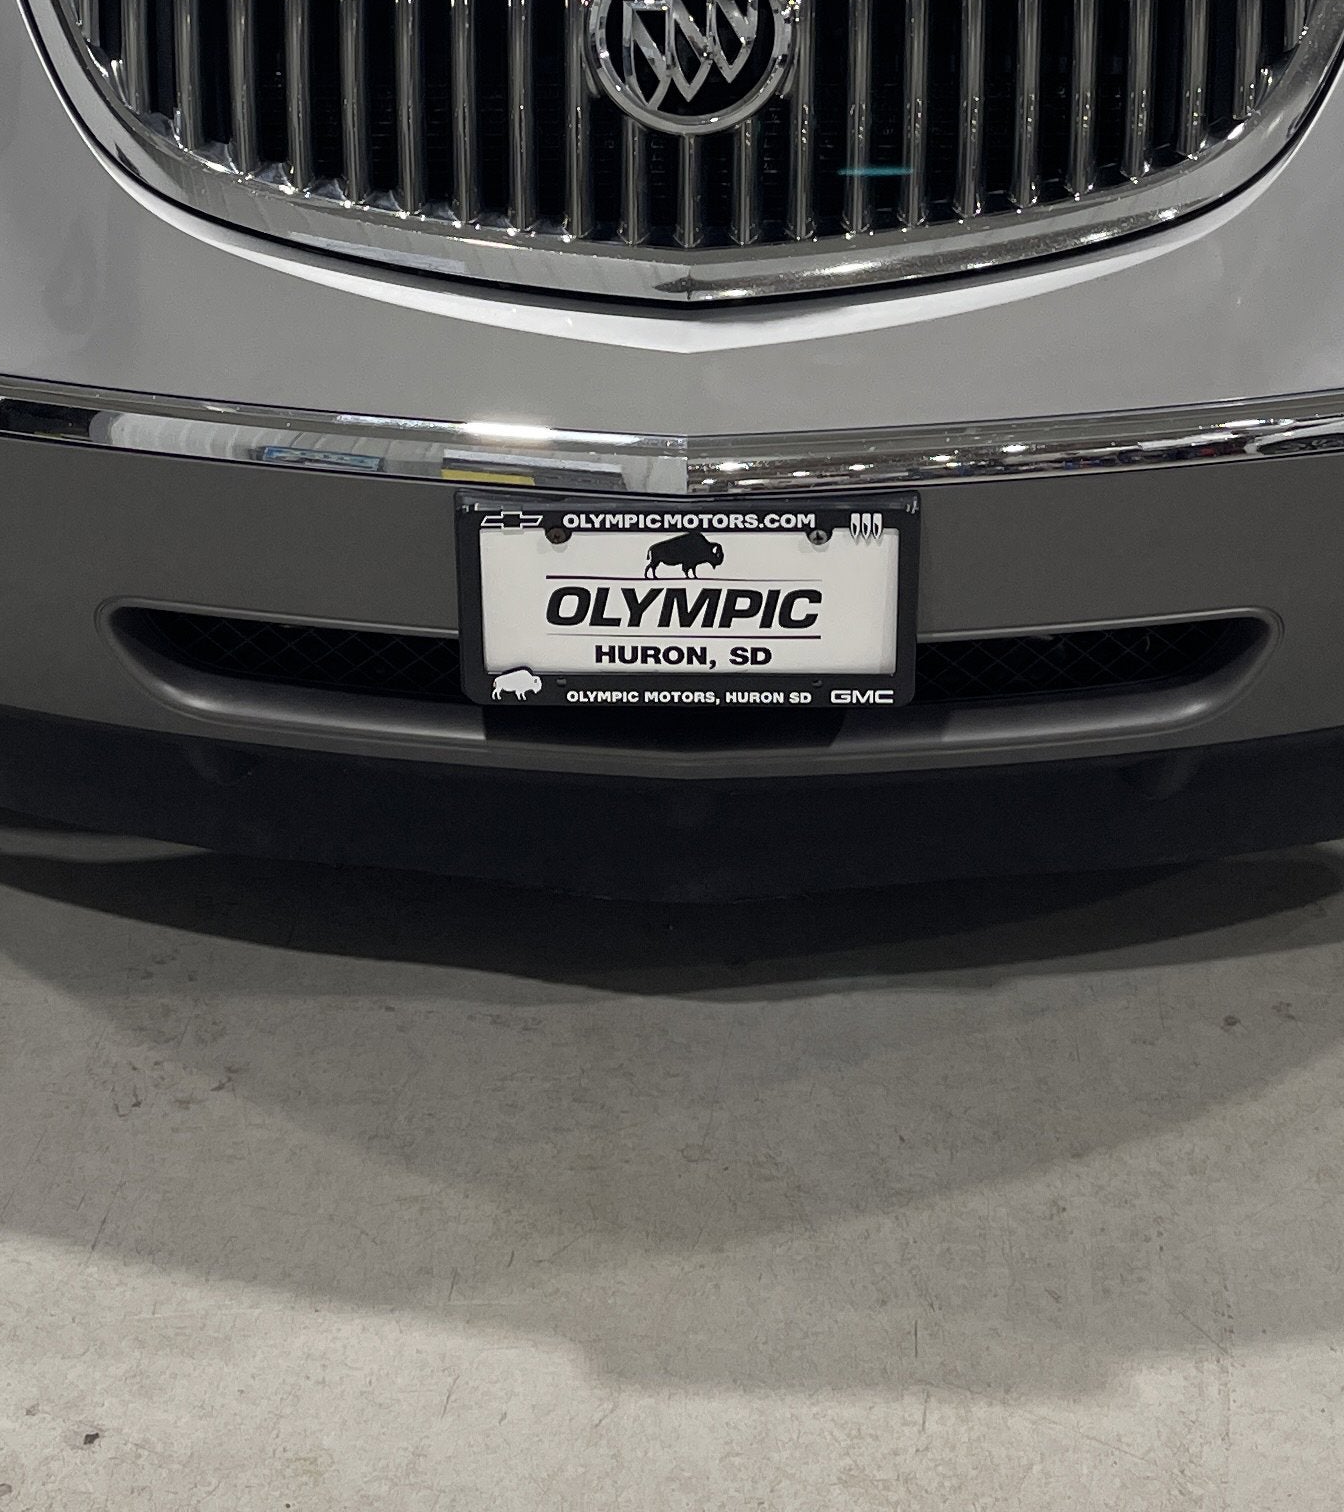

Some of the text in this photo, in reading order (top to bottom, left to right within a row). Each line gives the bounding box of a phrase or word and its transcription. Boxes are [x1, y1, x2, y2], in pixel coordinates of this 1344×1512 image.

[562, 513, 816, 529] OLYMPICMOTORS.COM
[545, 586, 822, 629] OLYMPIC
[595, 644, 773, 670] HURON, SD
[566, 691, 812, 706] OLYMPIC MOTORS, HURON SD
[830, 690, 894, 704] GMC
